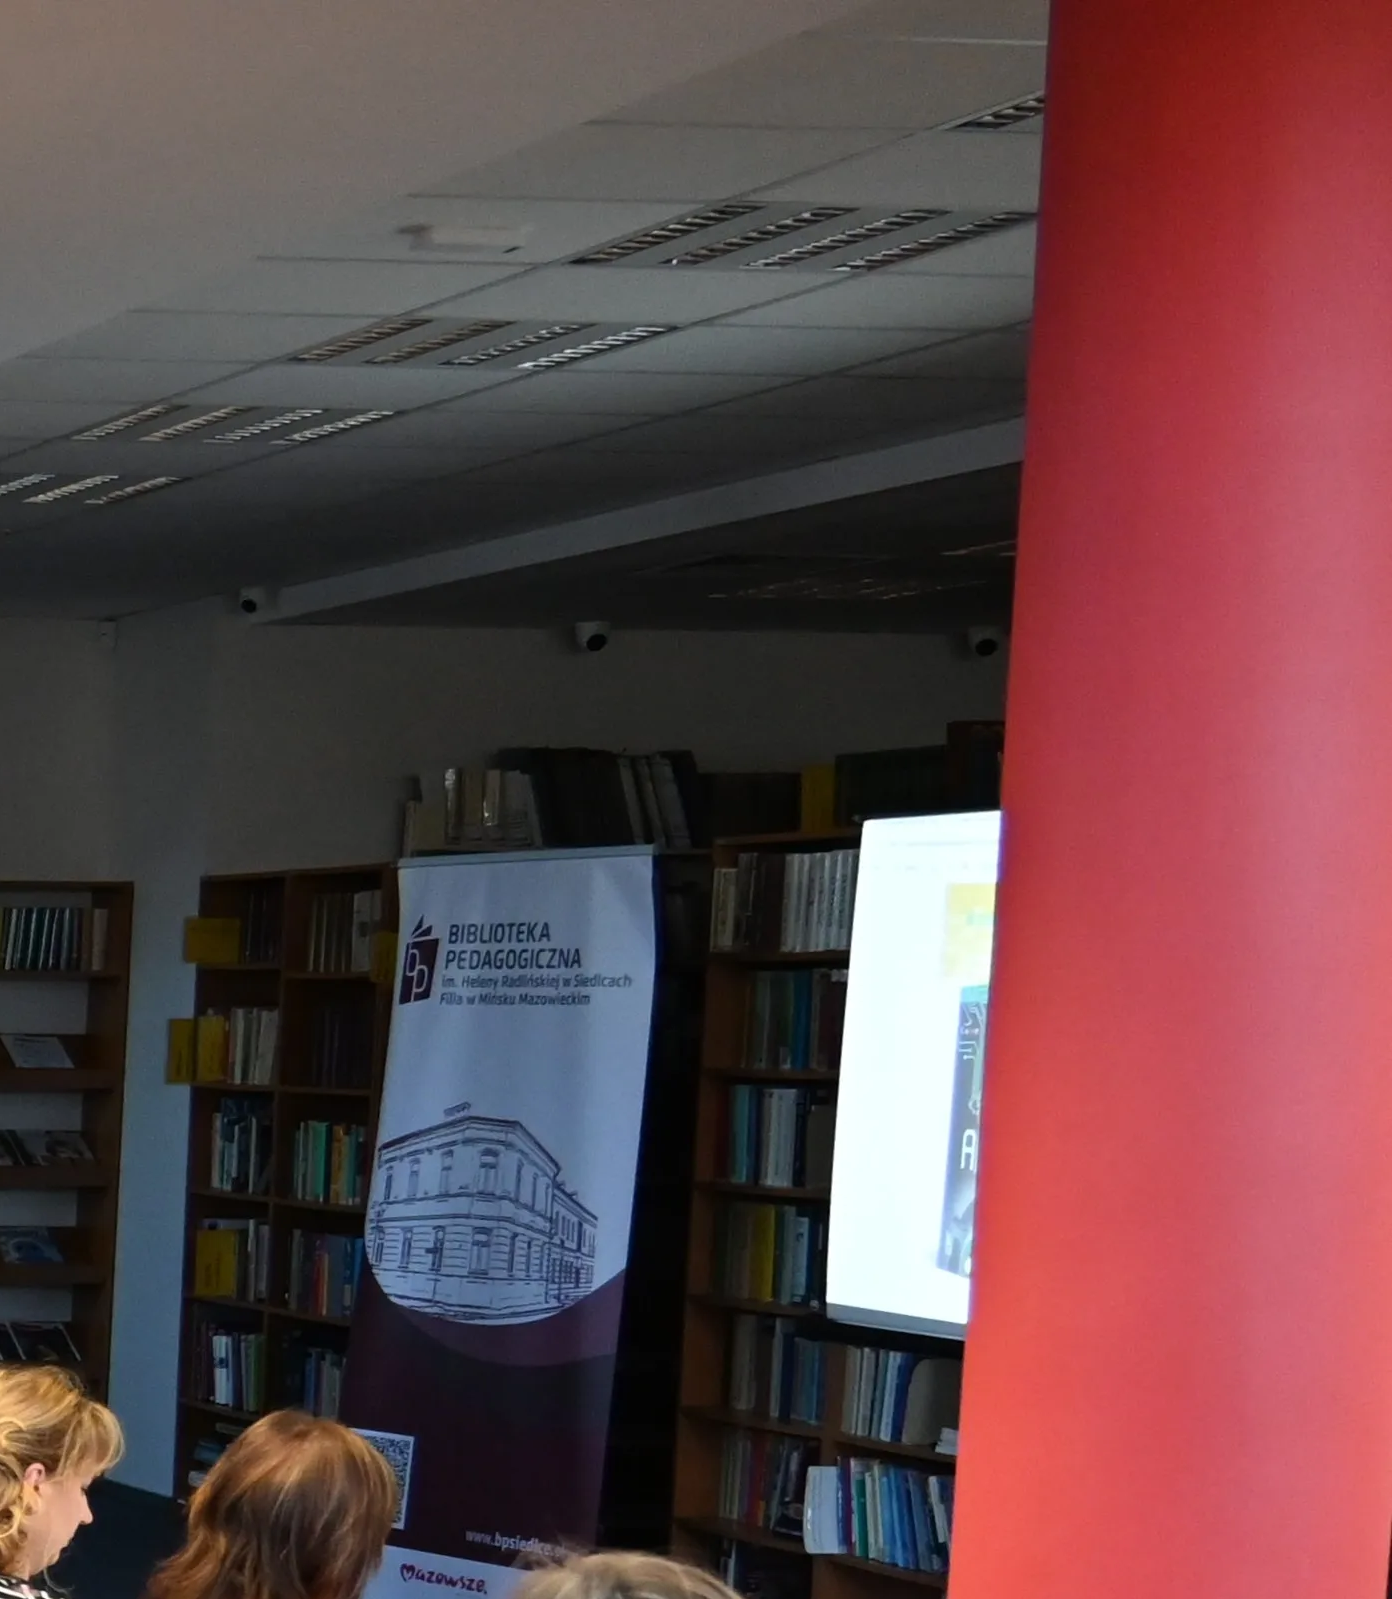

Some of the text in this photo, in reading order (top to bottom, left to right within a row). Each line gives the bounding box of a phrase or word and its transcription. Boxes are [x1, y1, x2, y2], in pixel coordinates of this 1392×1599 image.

[448, 921, 551, 945] BIBLIOTEKA
[444, 948, 582, 971] PEDAGOGICZNA
[441, 973, 632, 991] im. Heleny Radlińskiej w Siedlcach
[439, 992, 592, 1005] Filia w Mińsku Mazowieckim
